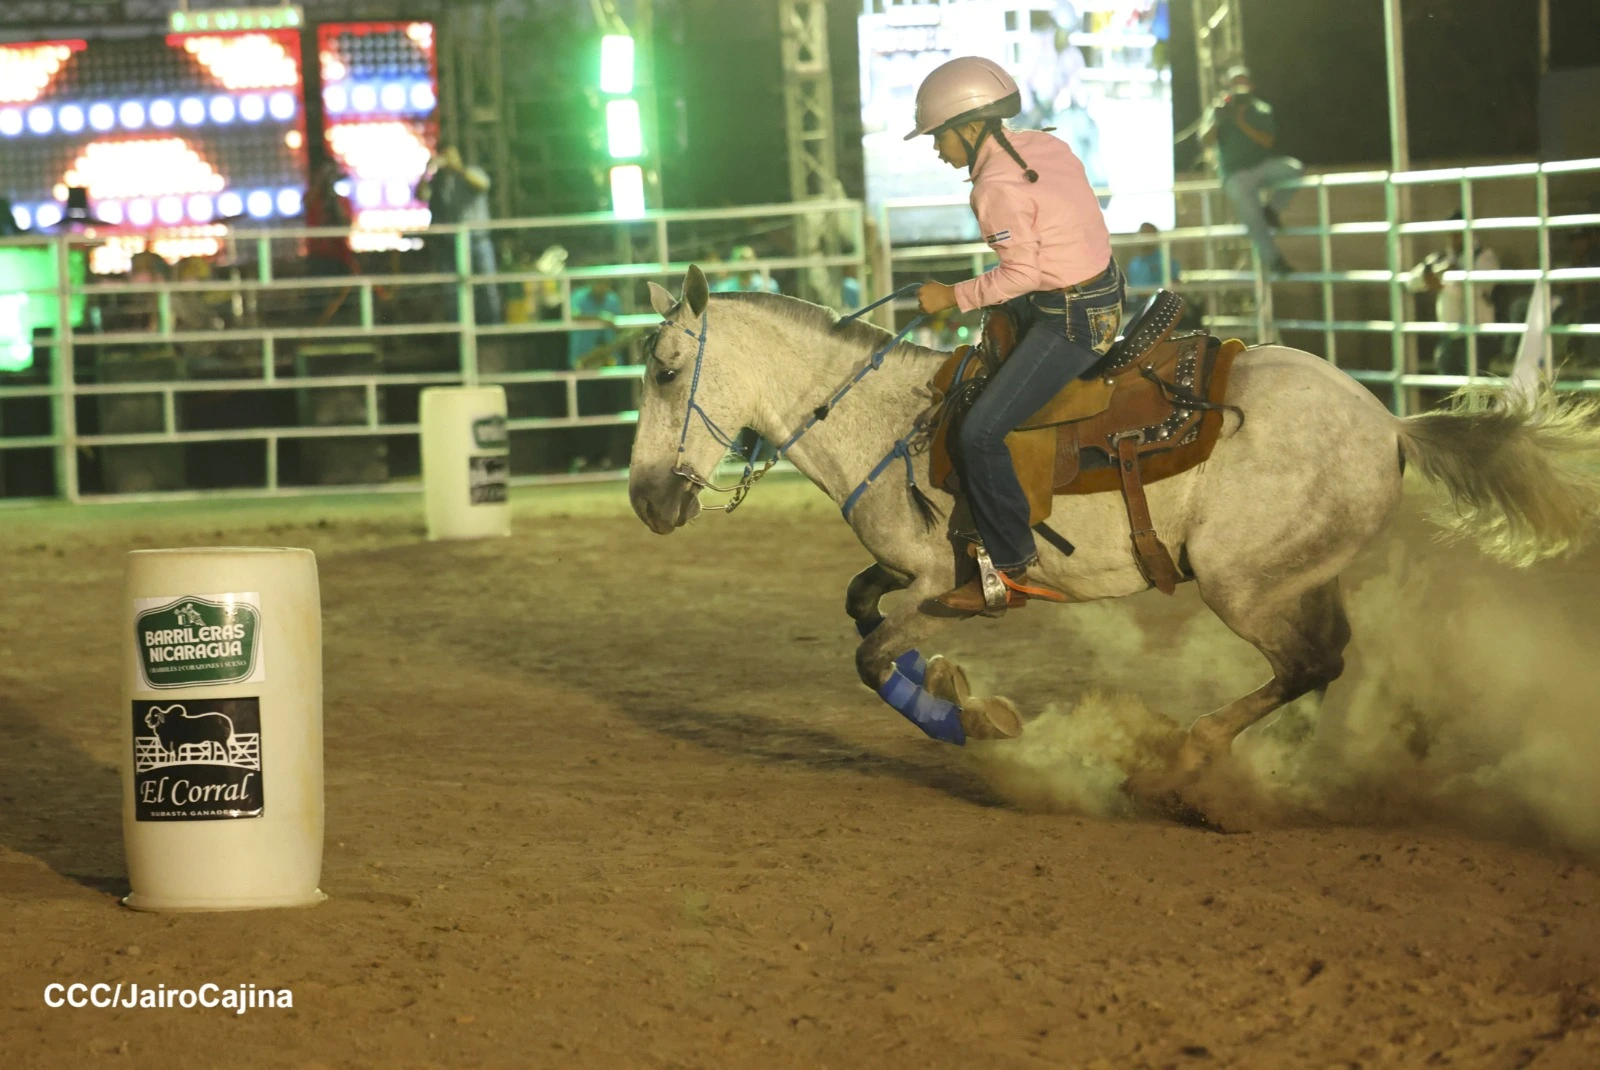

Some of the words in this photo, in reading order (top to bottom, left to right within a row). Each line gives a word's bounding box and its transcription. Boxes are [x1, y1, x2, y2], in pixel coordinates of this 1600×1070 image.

[145, 624, 245, 646] BARRILERAS
[149, 640, 242, 662] NICARAGUA
[181, 663, 219, 671] CORAZONES
[140, 776, 169, 803] El
[171, 773, 254, 806] Corral
